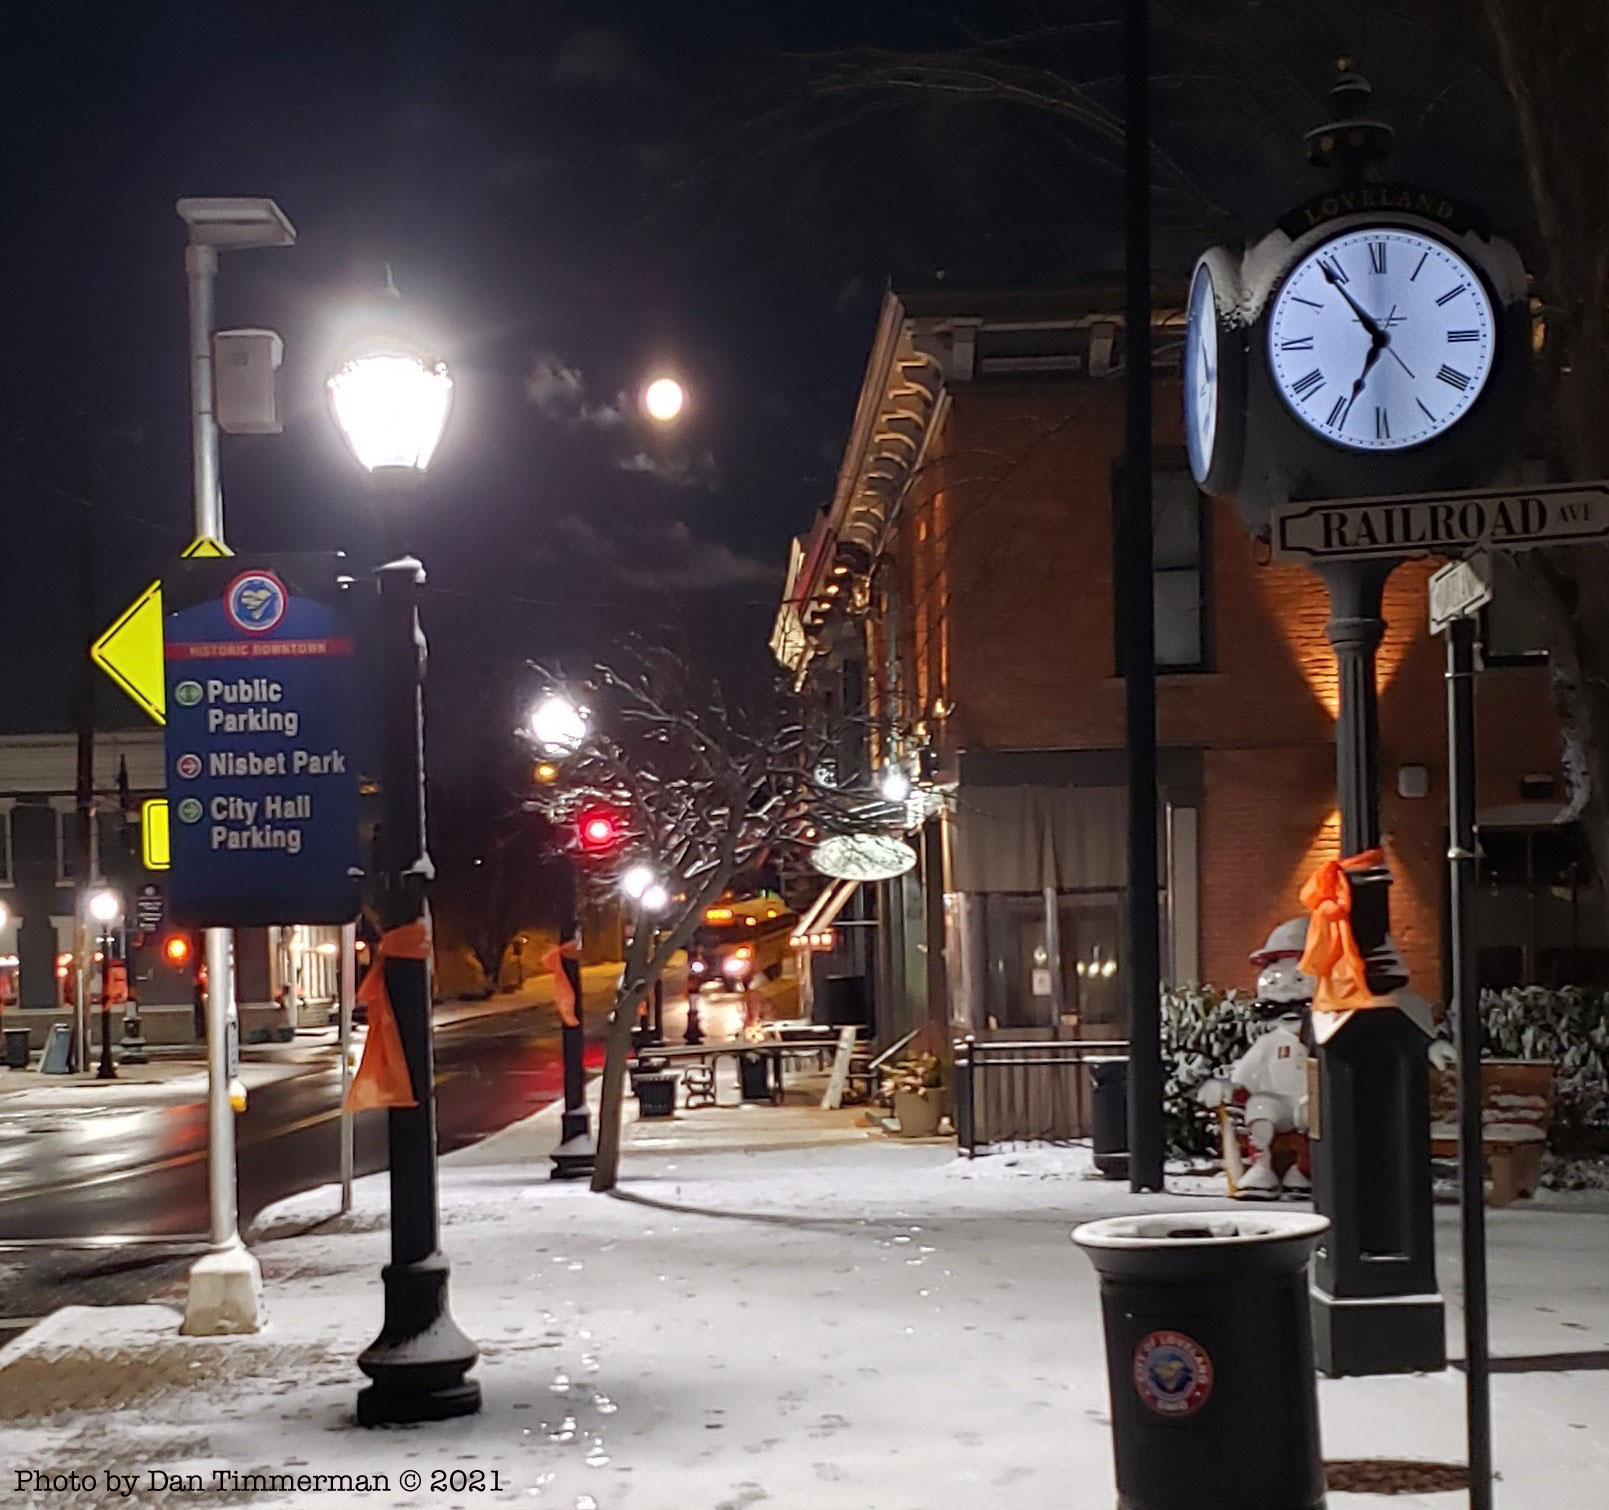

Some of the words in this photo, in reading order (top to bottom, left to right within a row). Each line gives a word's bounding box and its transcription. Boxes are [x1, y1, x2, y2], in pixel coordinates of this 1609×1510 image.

[1305, 189, 1453, 223] LOVELAND
[1447, 329, 1481, 343] III
[1320, 498, 1548, 548] RAILROAD
[190, 644, 249, 657] HISTORIC
[253, 642, 327, 656] DOWNTOWN
[207, 679, 282, 703] Public
[208, 708, 299, 737] Parking
[210, 752, 286, 776] Nisbet
[293, 750, 346, 774] Park
[211, 796, 258, 825] City
[265, 795, 311, 819] Hall
[211, 824, 301, 853] Parking
